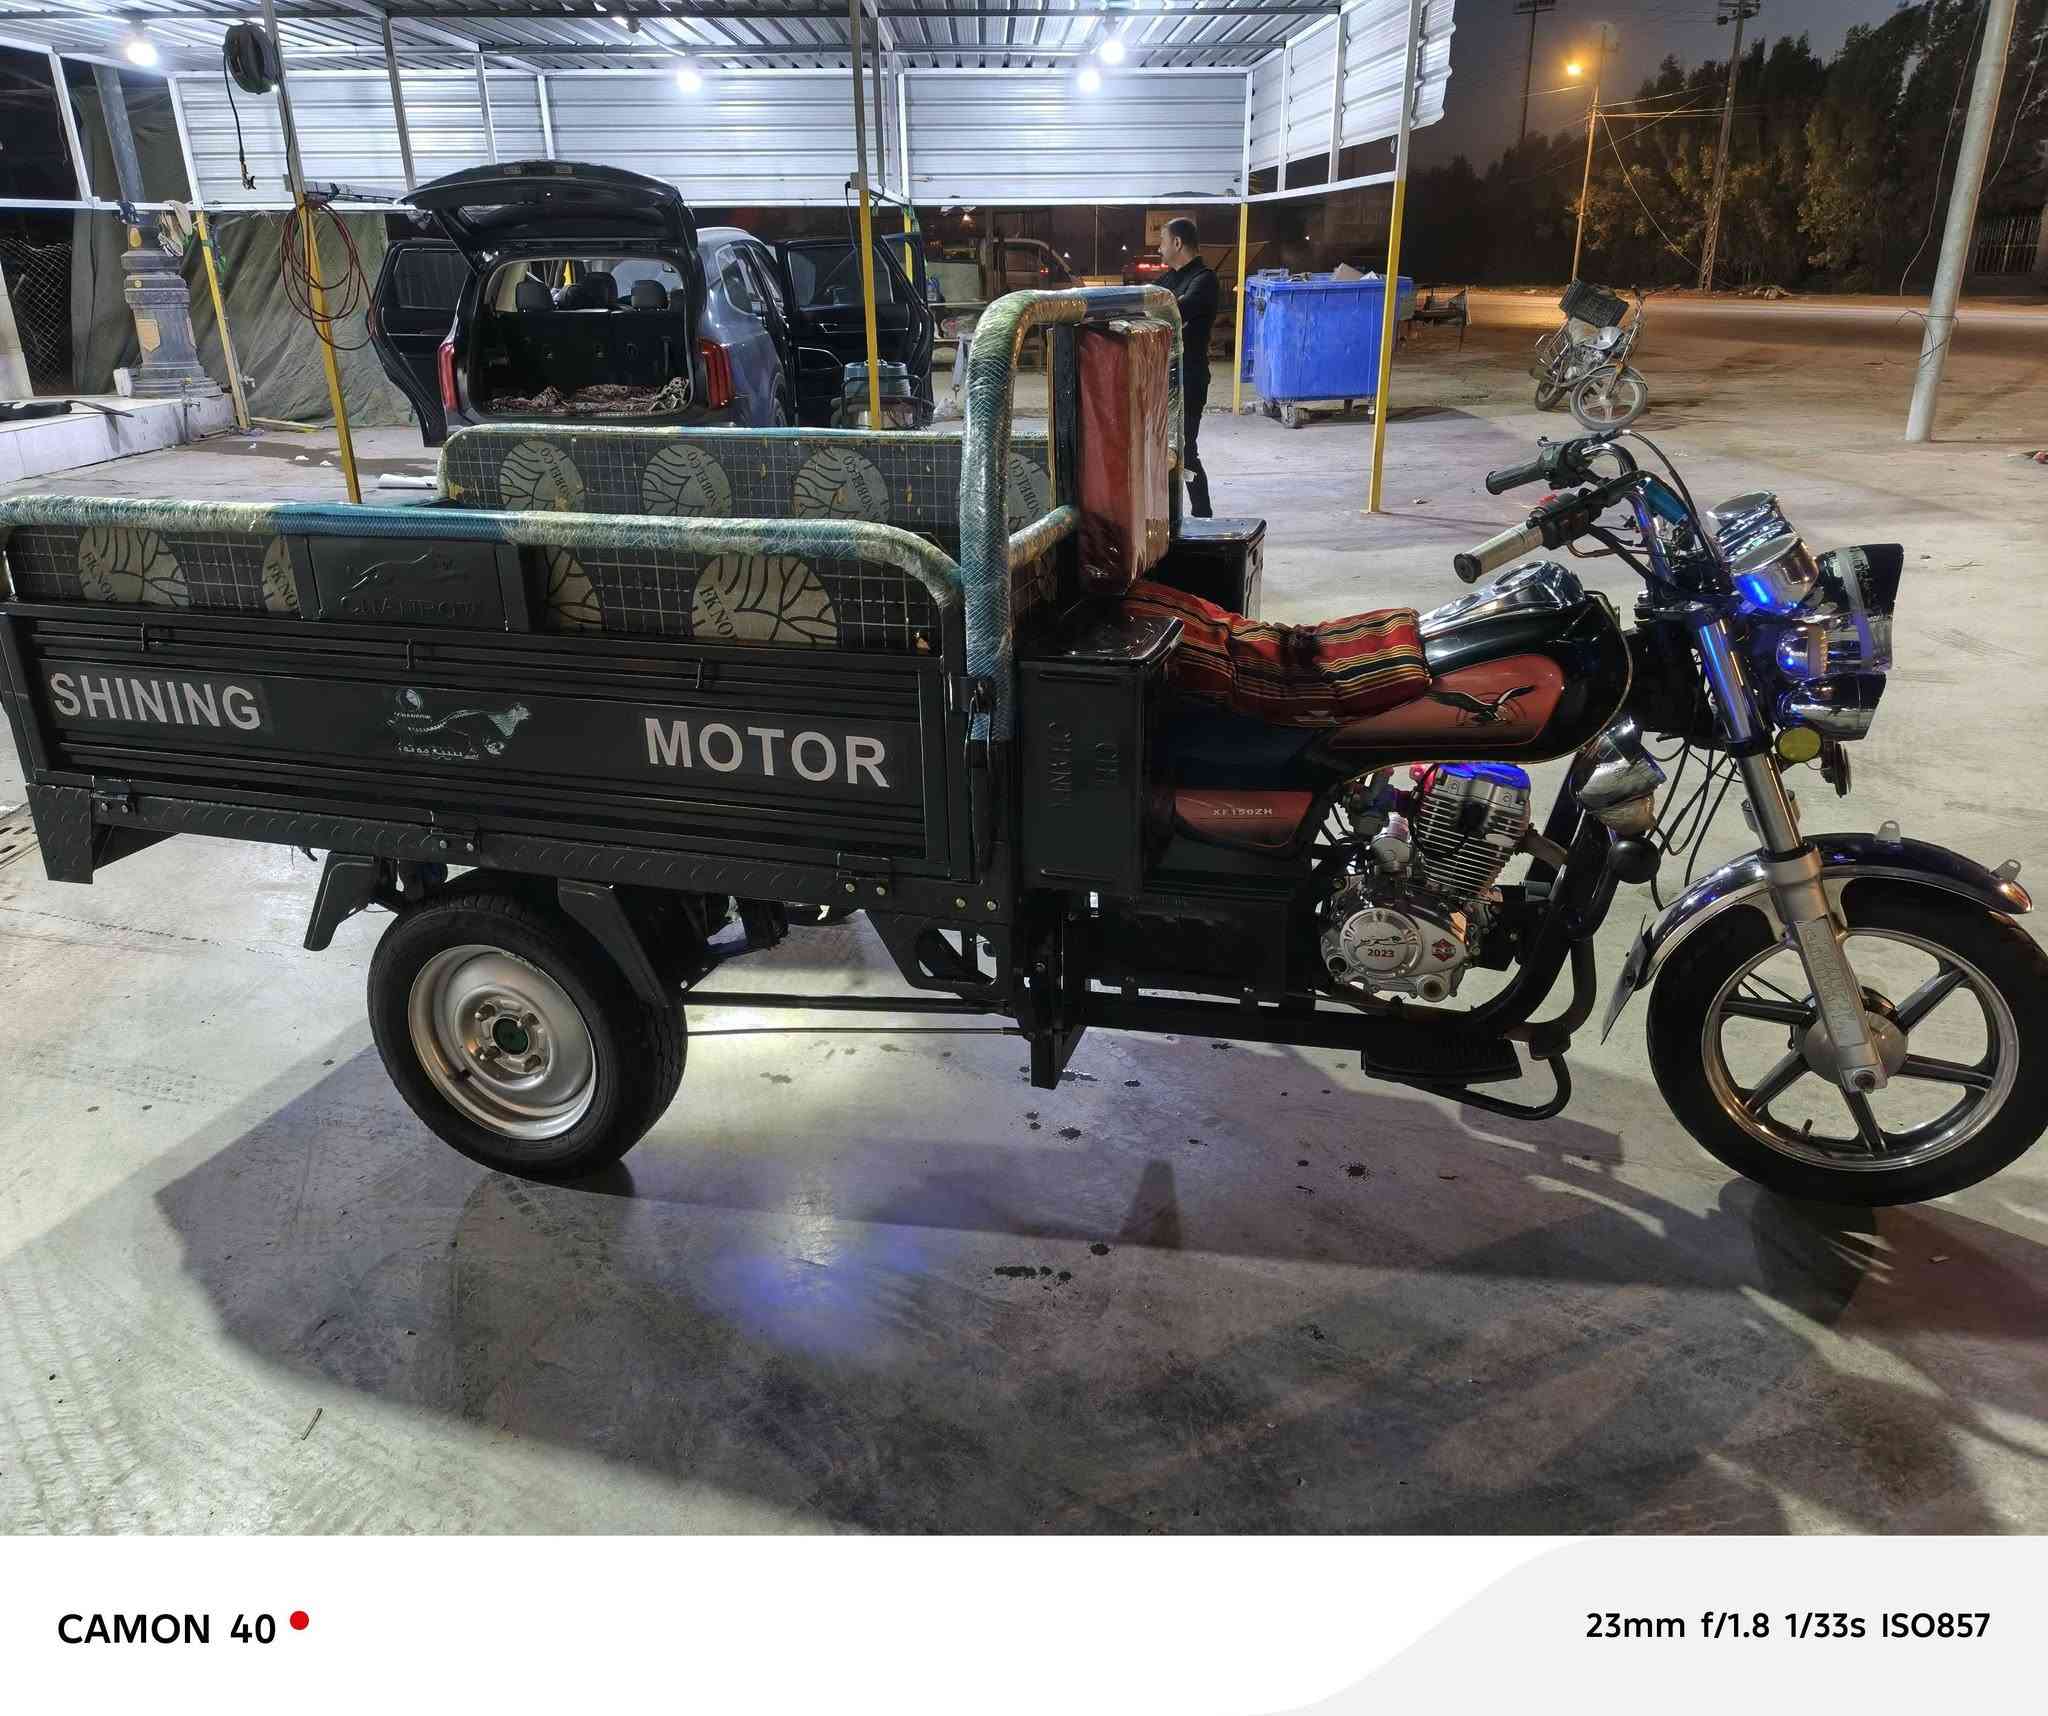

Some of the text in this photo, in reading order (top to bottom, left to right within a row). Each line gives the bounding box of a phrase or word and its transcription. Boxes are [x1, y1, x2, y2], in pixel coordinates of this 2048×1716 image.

[49, 672, 890, 788] SHINING MOTOR
[1367, 947, 1395, 958] 2023
